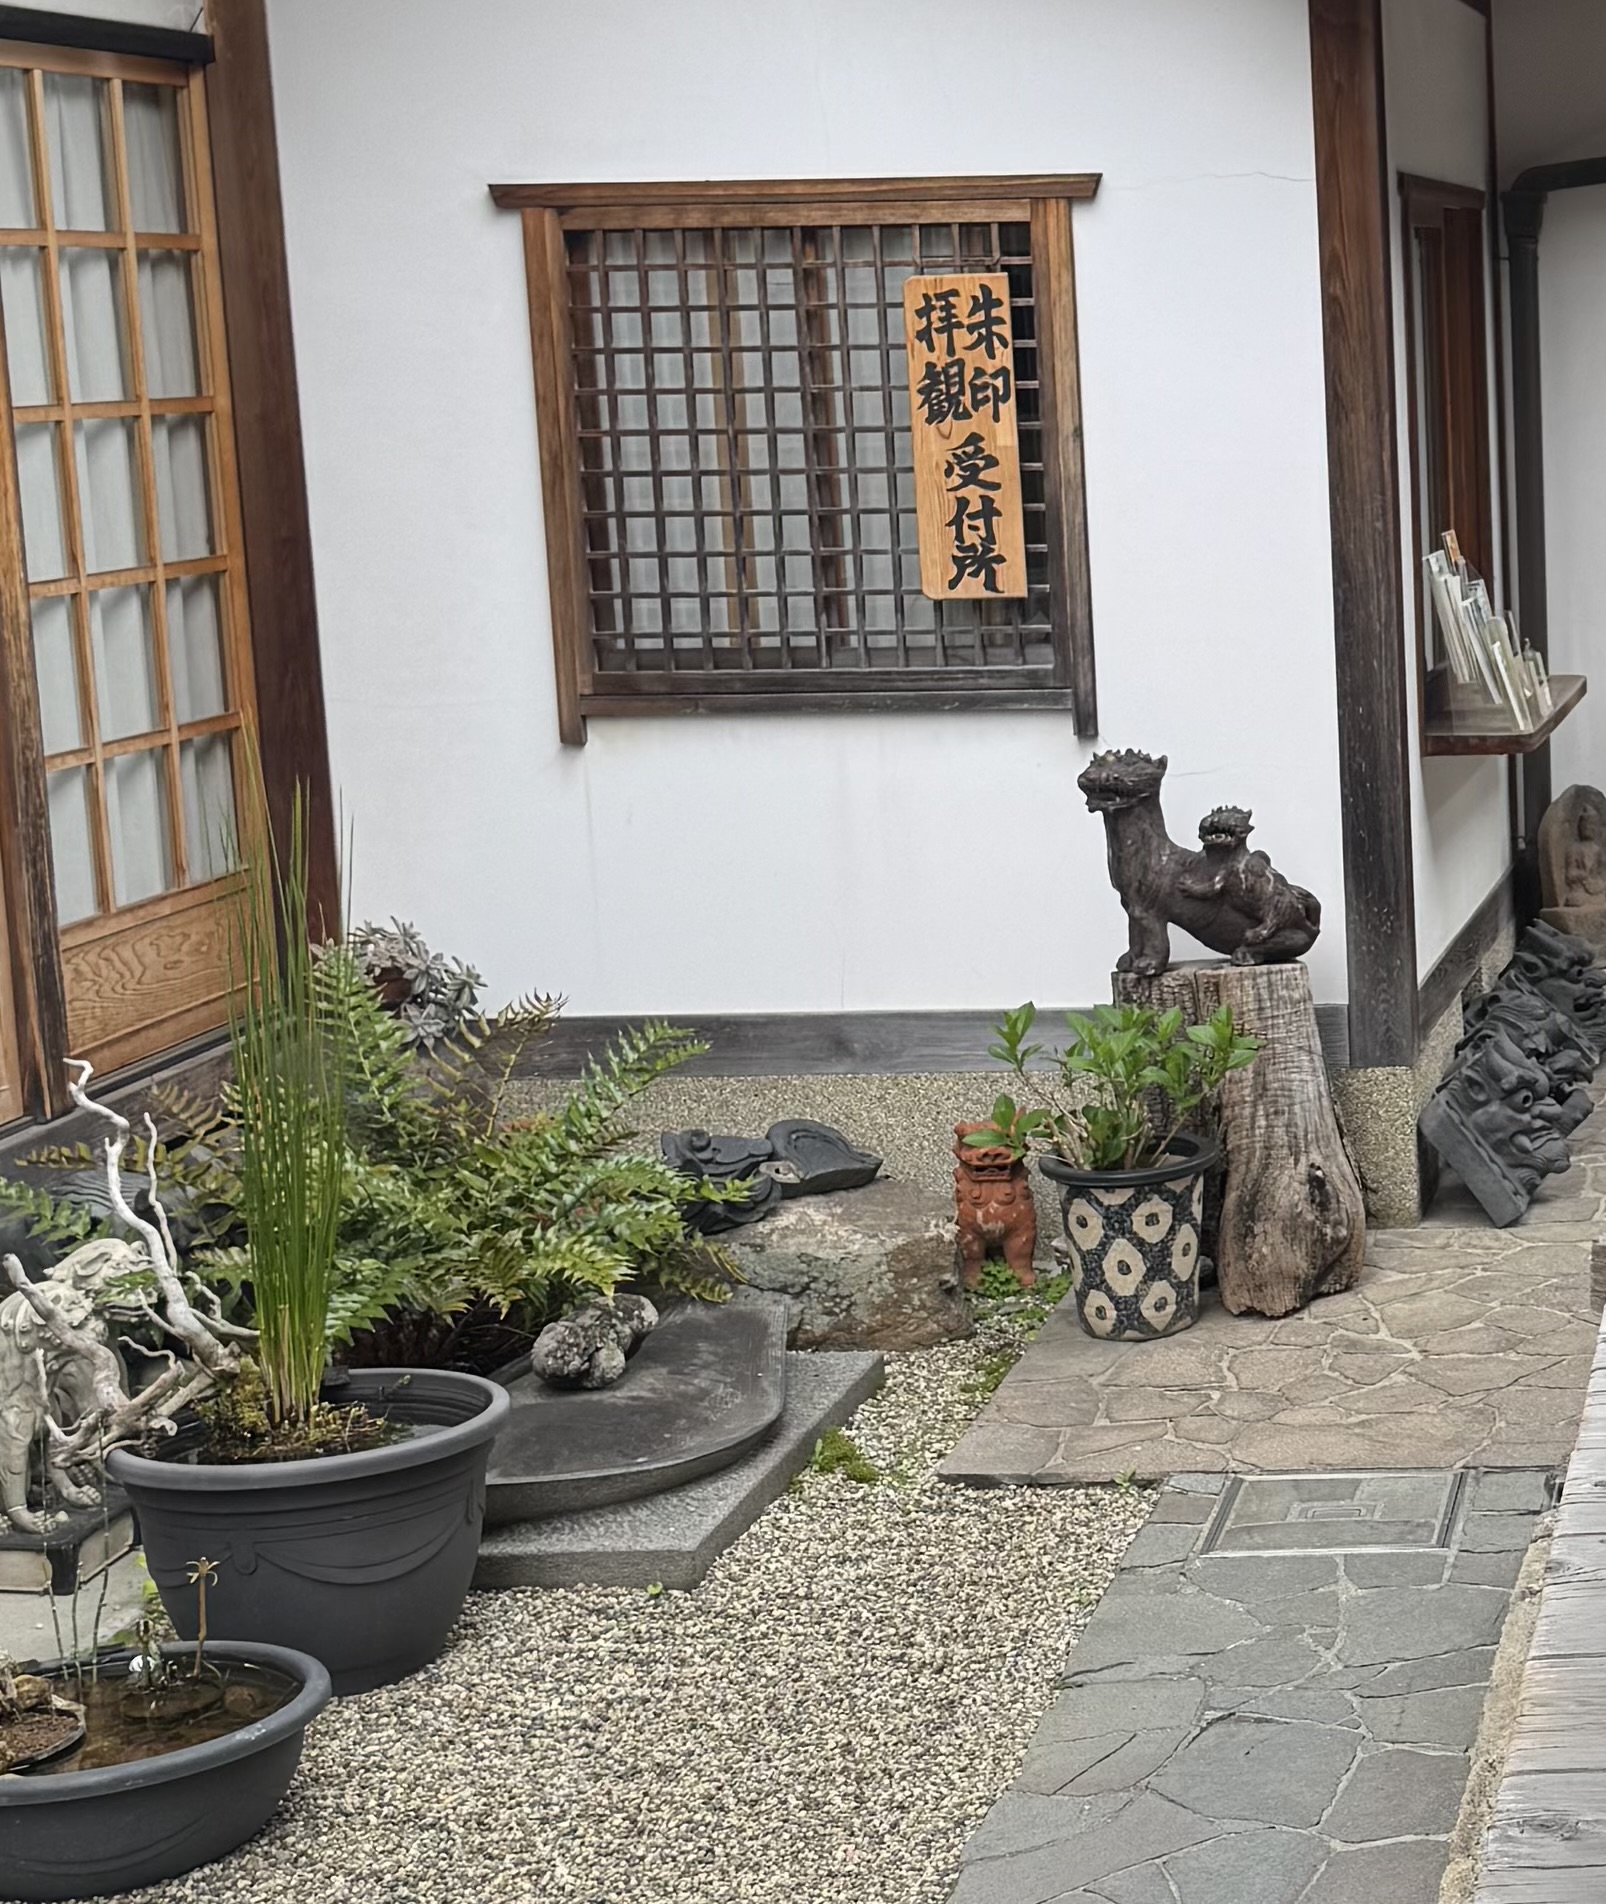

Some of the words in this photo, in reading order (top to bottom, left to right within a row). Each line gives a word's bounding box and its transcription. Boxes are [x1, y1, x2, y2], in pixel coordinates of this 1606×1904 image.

[914, 288, 973, 426] 拝観
[963, 283, 1011, 423] 朱印
[944, 432, 1007, 594] 受付所
